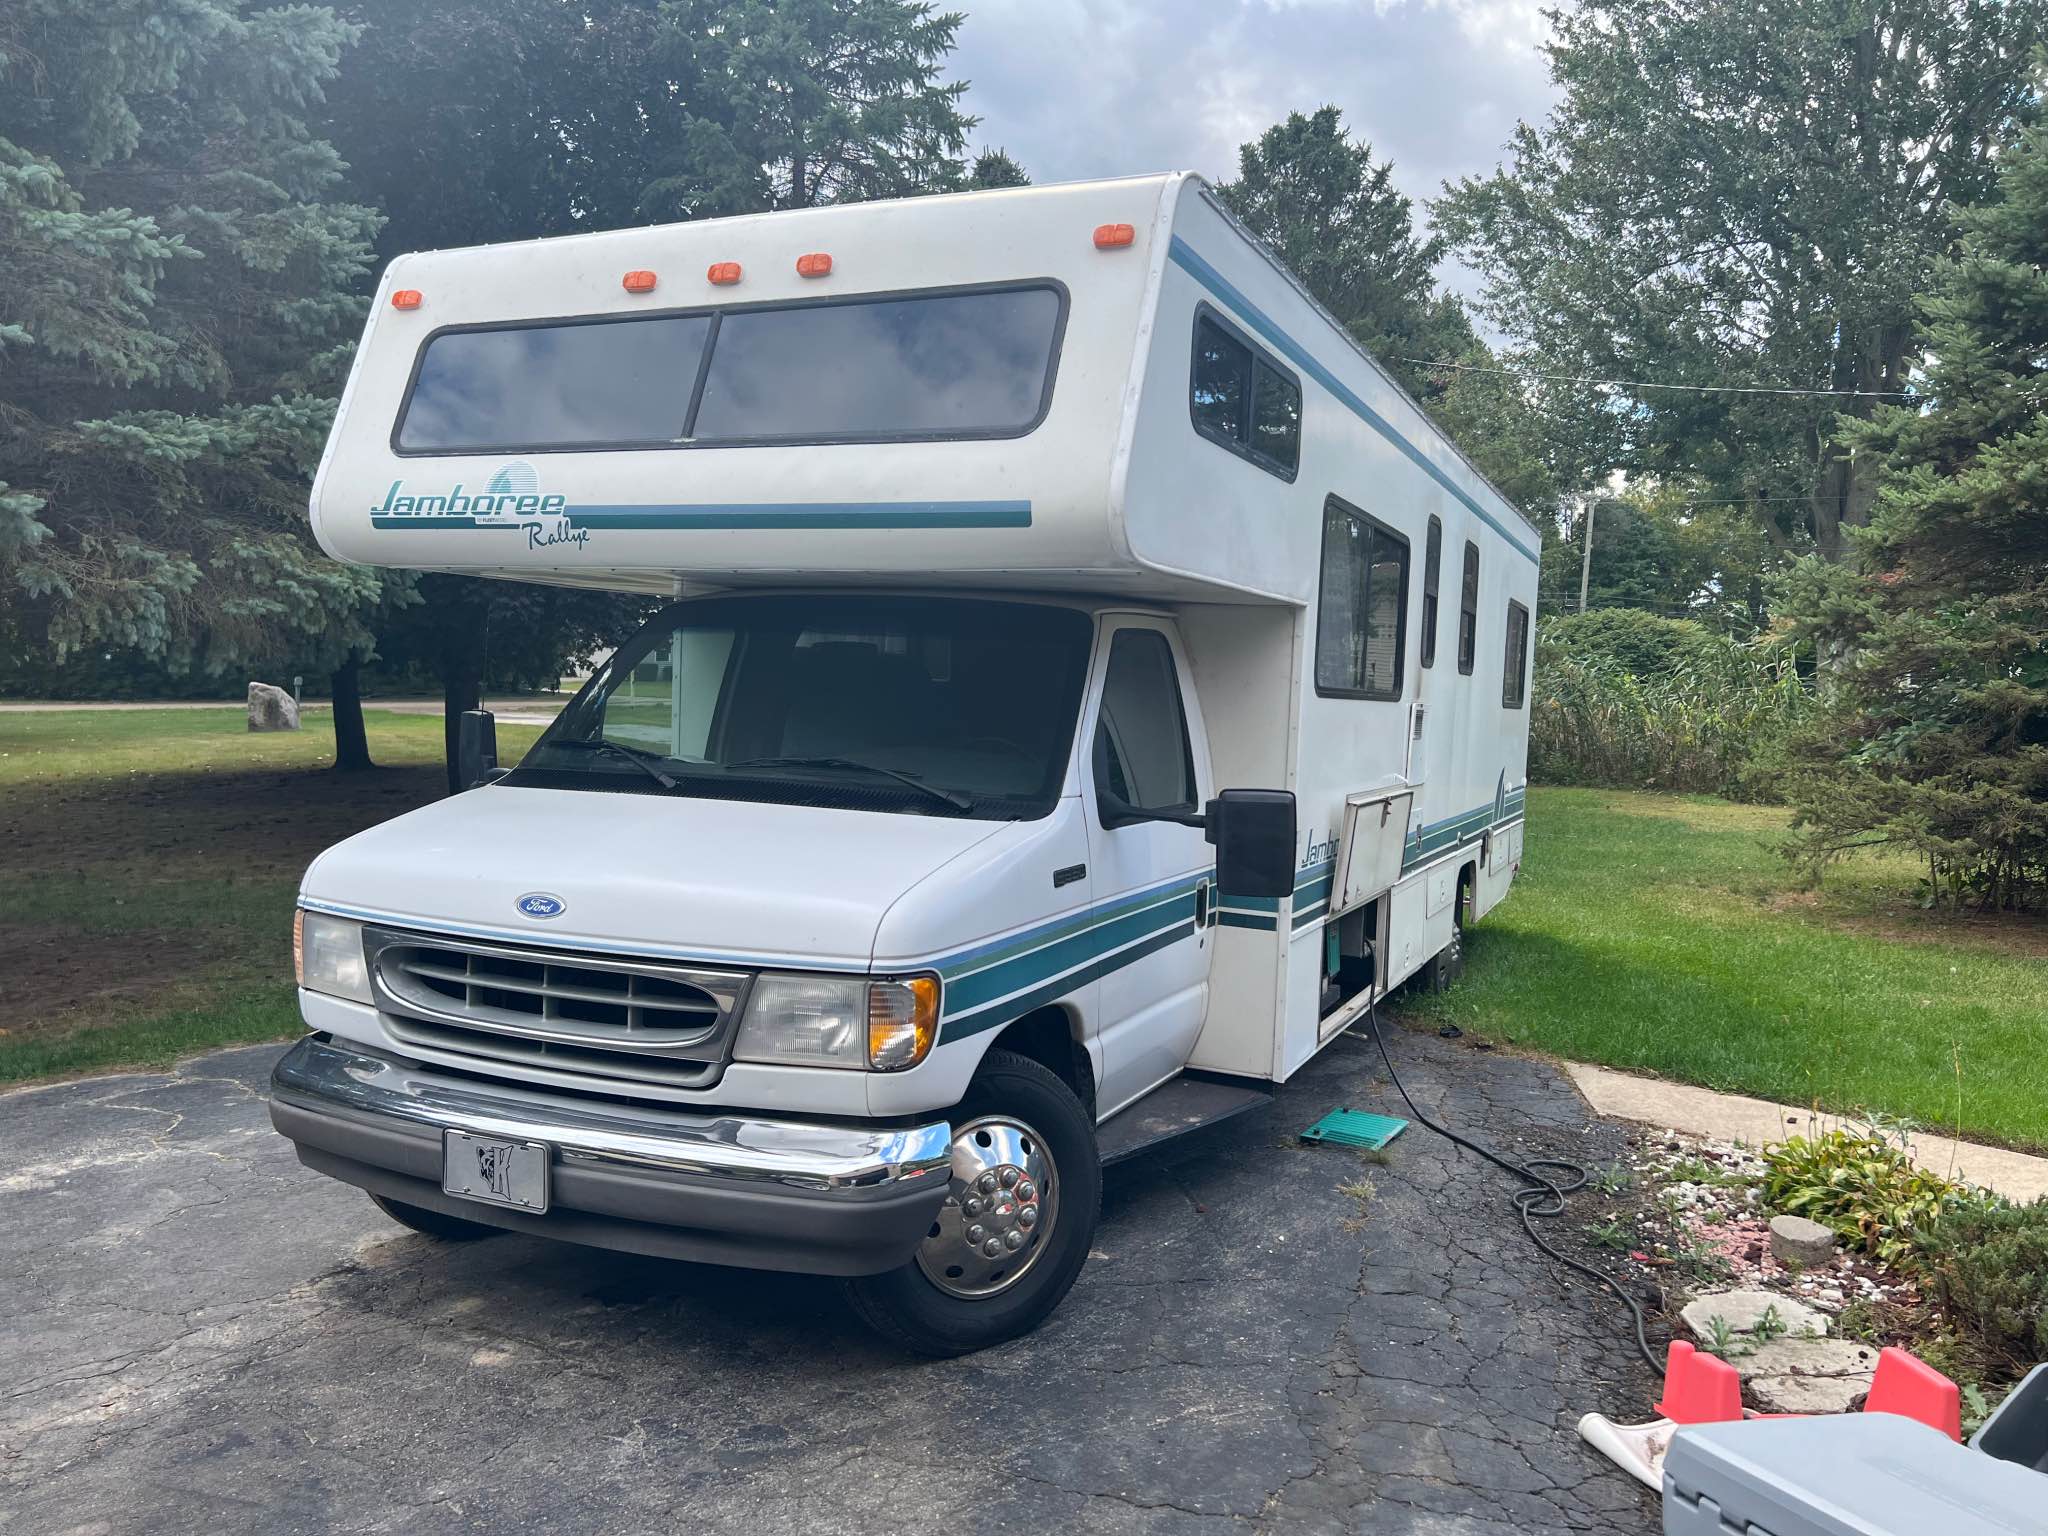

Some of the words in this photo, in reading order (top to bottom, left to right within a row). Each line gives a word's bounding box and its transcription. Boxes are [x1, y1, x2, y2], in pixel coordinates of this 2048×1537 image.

[370, 481, 565, 516] Jamboree
[521, 521, 590, 551] Rallye
[526, 898, 554, 913] Ford
